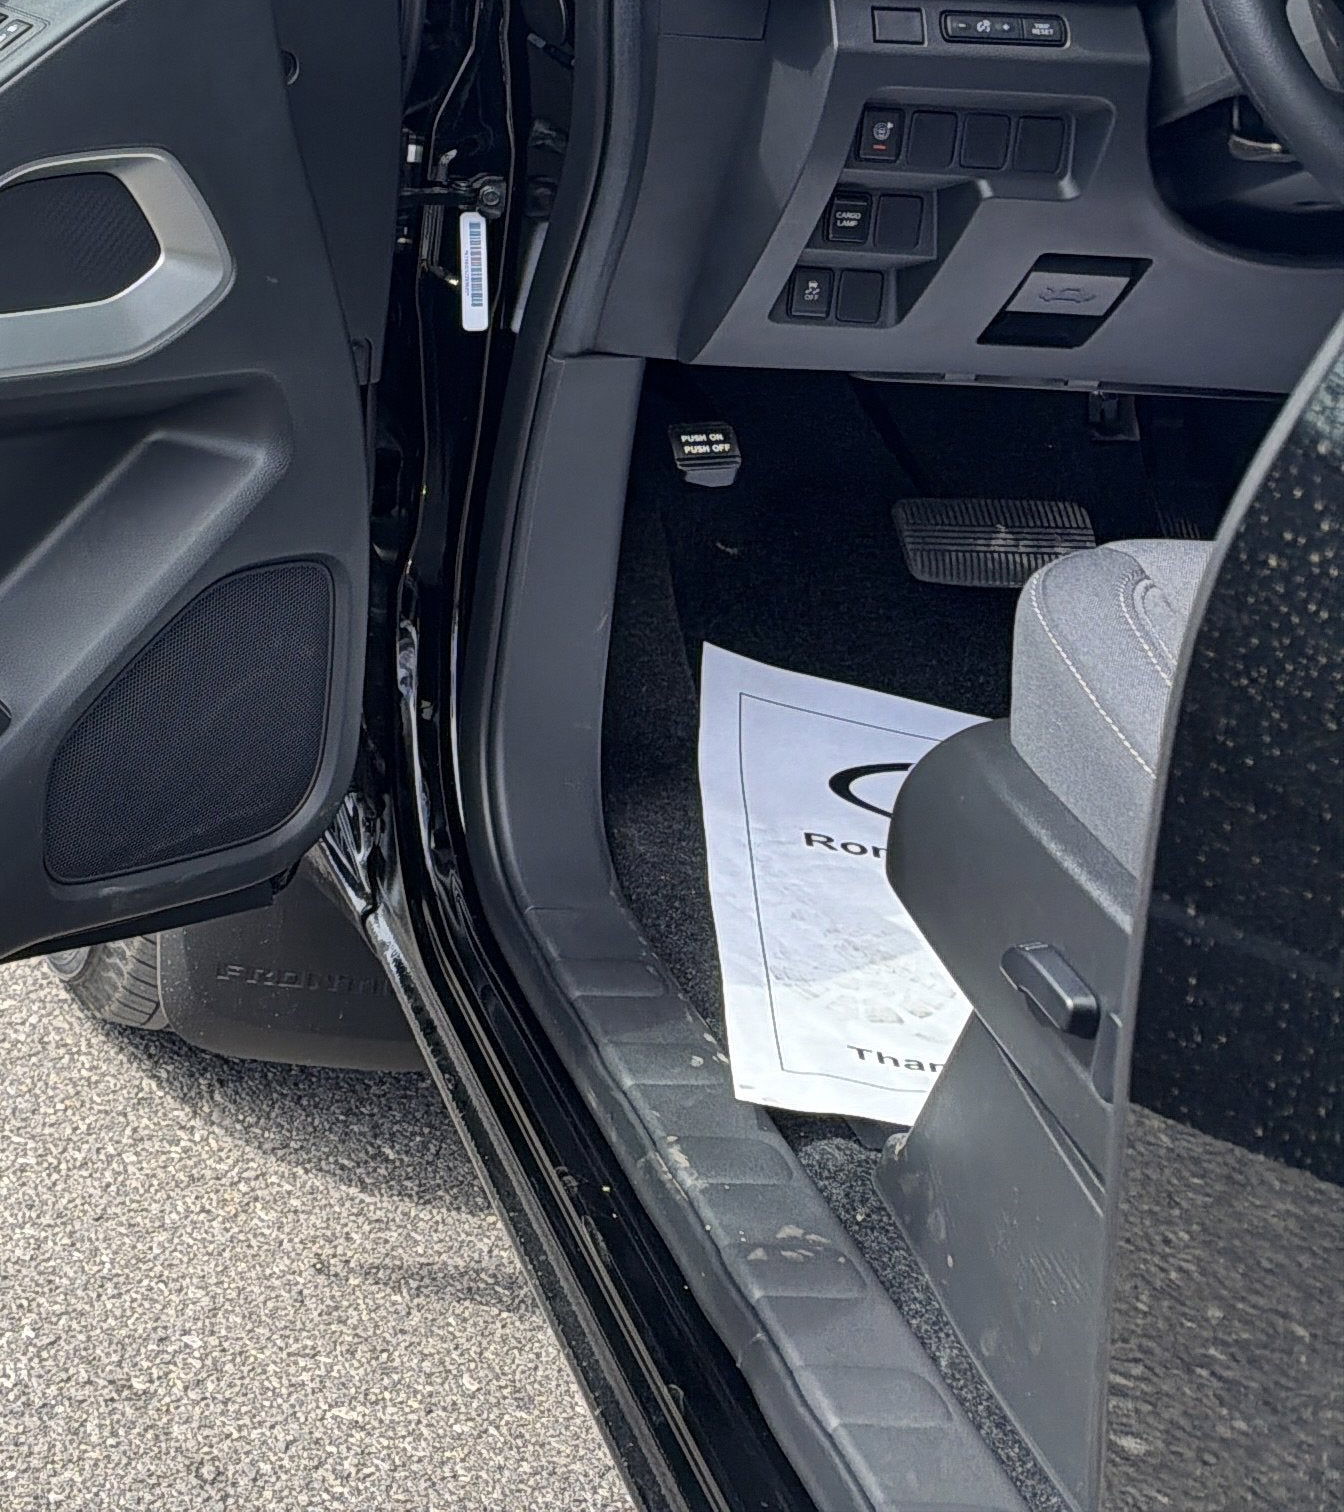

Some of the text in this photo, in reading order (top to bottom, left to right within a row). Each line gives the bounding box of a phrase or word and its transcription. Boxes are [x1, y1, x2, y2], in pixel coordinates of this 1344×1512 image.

[680, 433, 724, 442] PUSH ON
[684, 443, 731, 454] PUSH OFF
